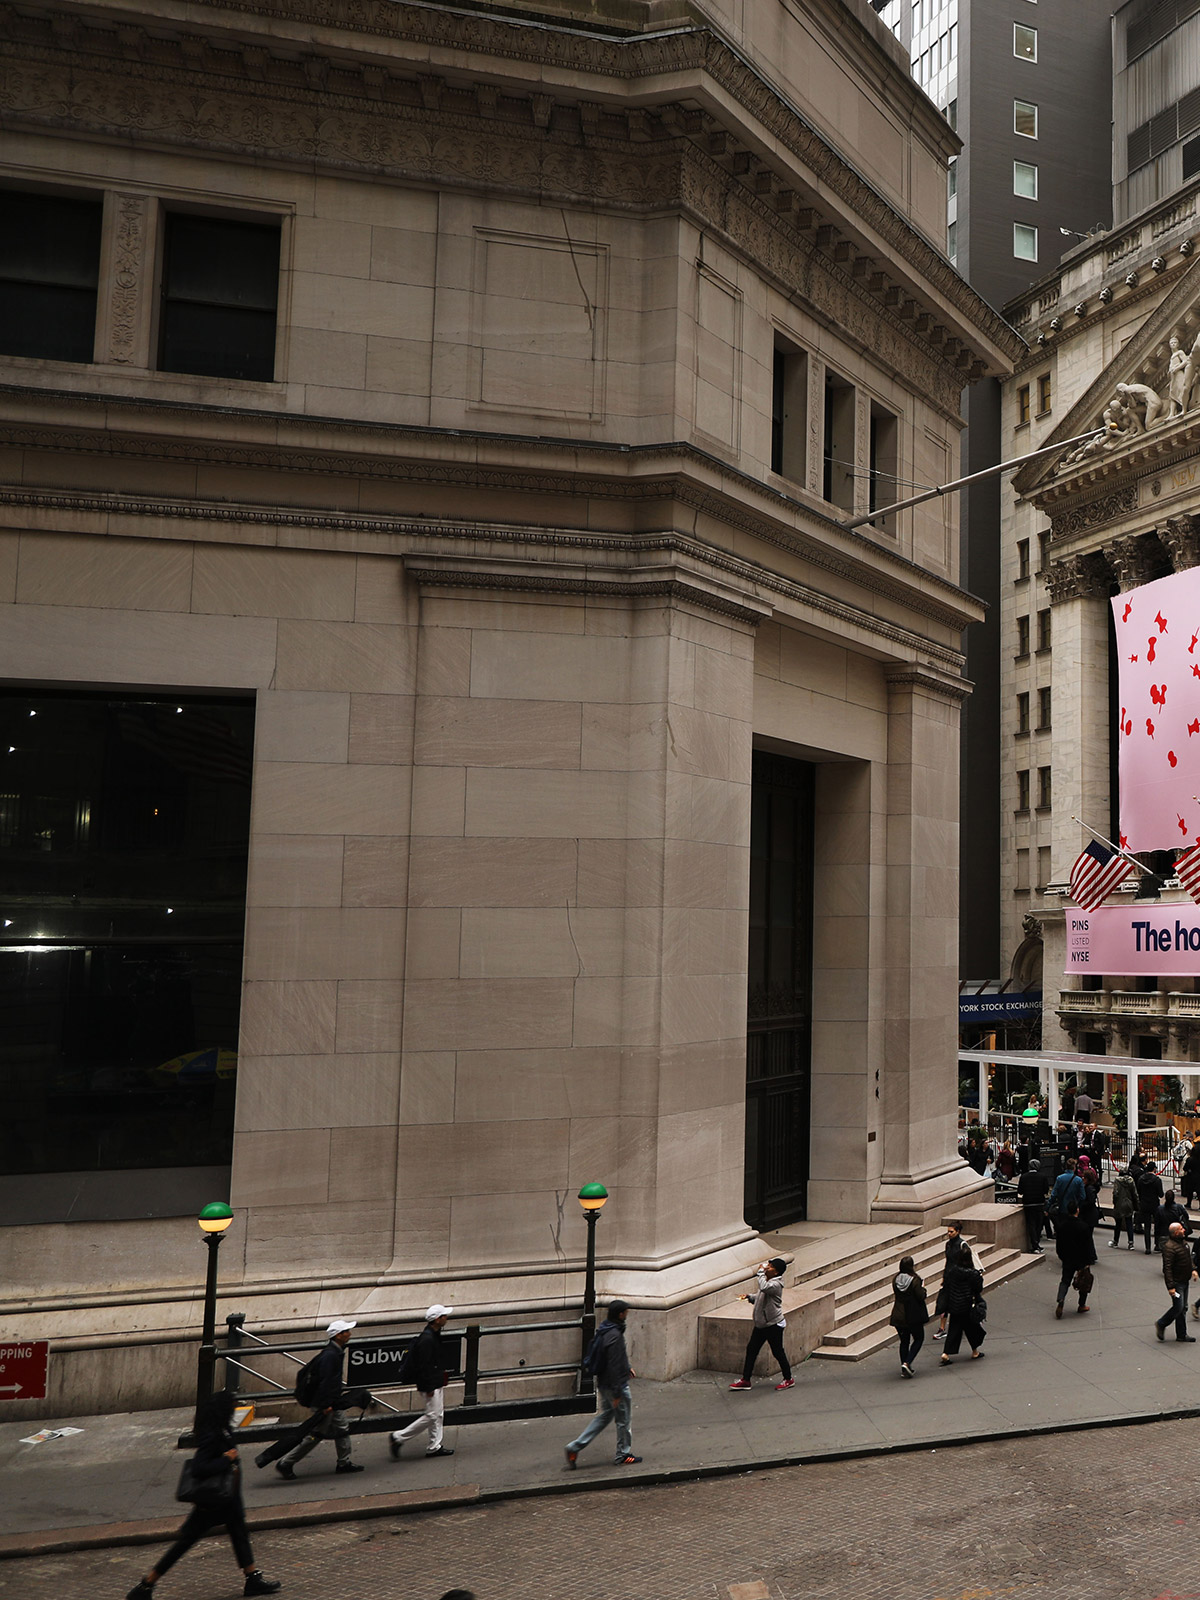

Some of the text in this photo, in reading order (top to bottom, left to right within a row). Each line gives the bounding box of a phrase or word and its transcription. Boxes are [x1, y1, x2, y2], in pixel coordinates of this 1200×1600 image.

[1171, 465, 1198, 489] NEW
[1072, 920, 1089, 931] PINS
[1072, 937, 1090, 945] LISTED
[1131, 921, 1172, 952] The
[1071, 951, 1090, 962] NYSE
[960, 1001, 1043, 1013] YORK STOCK EXCHANGE
[997, 1196, 1017, 1204] Station
[351, 1349, 405, 1365] Subw
